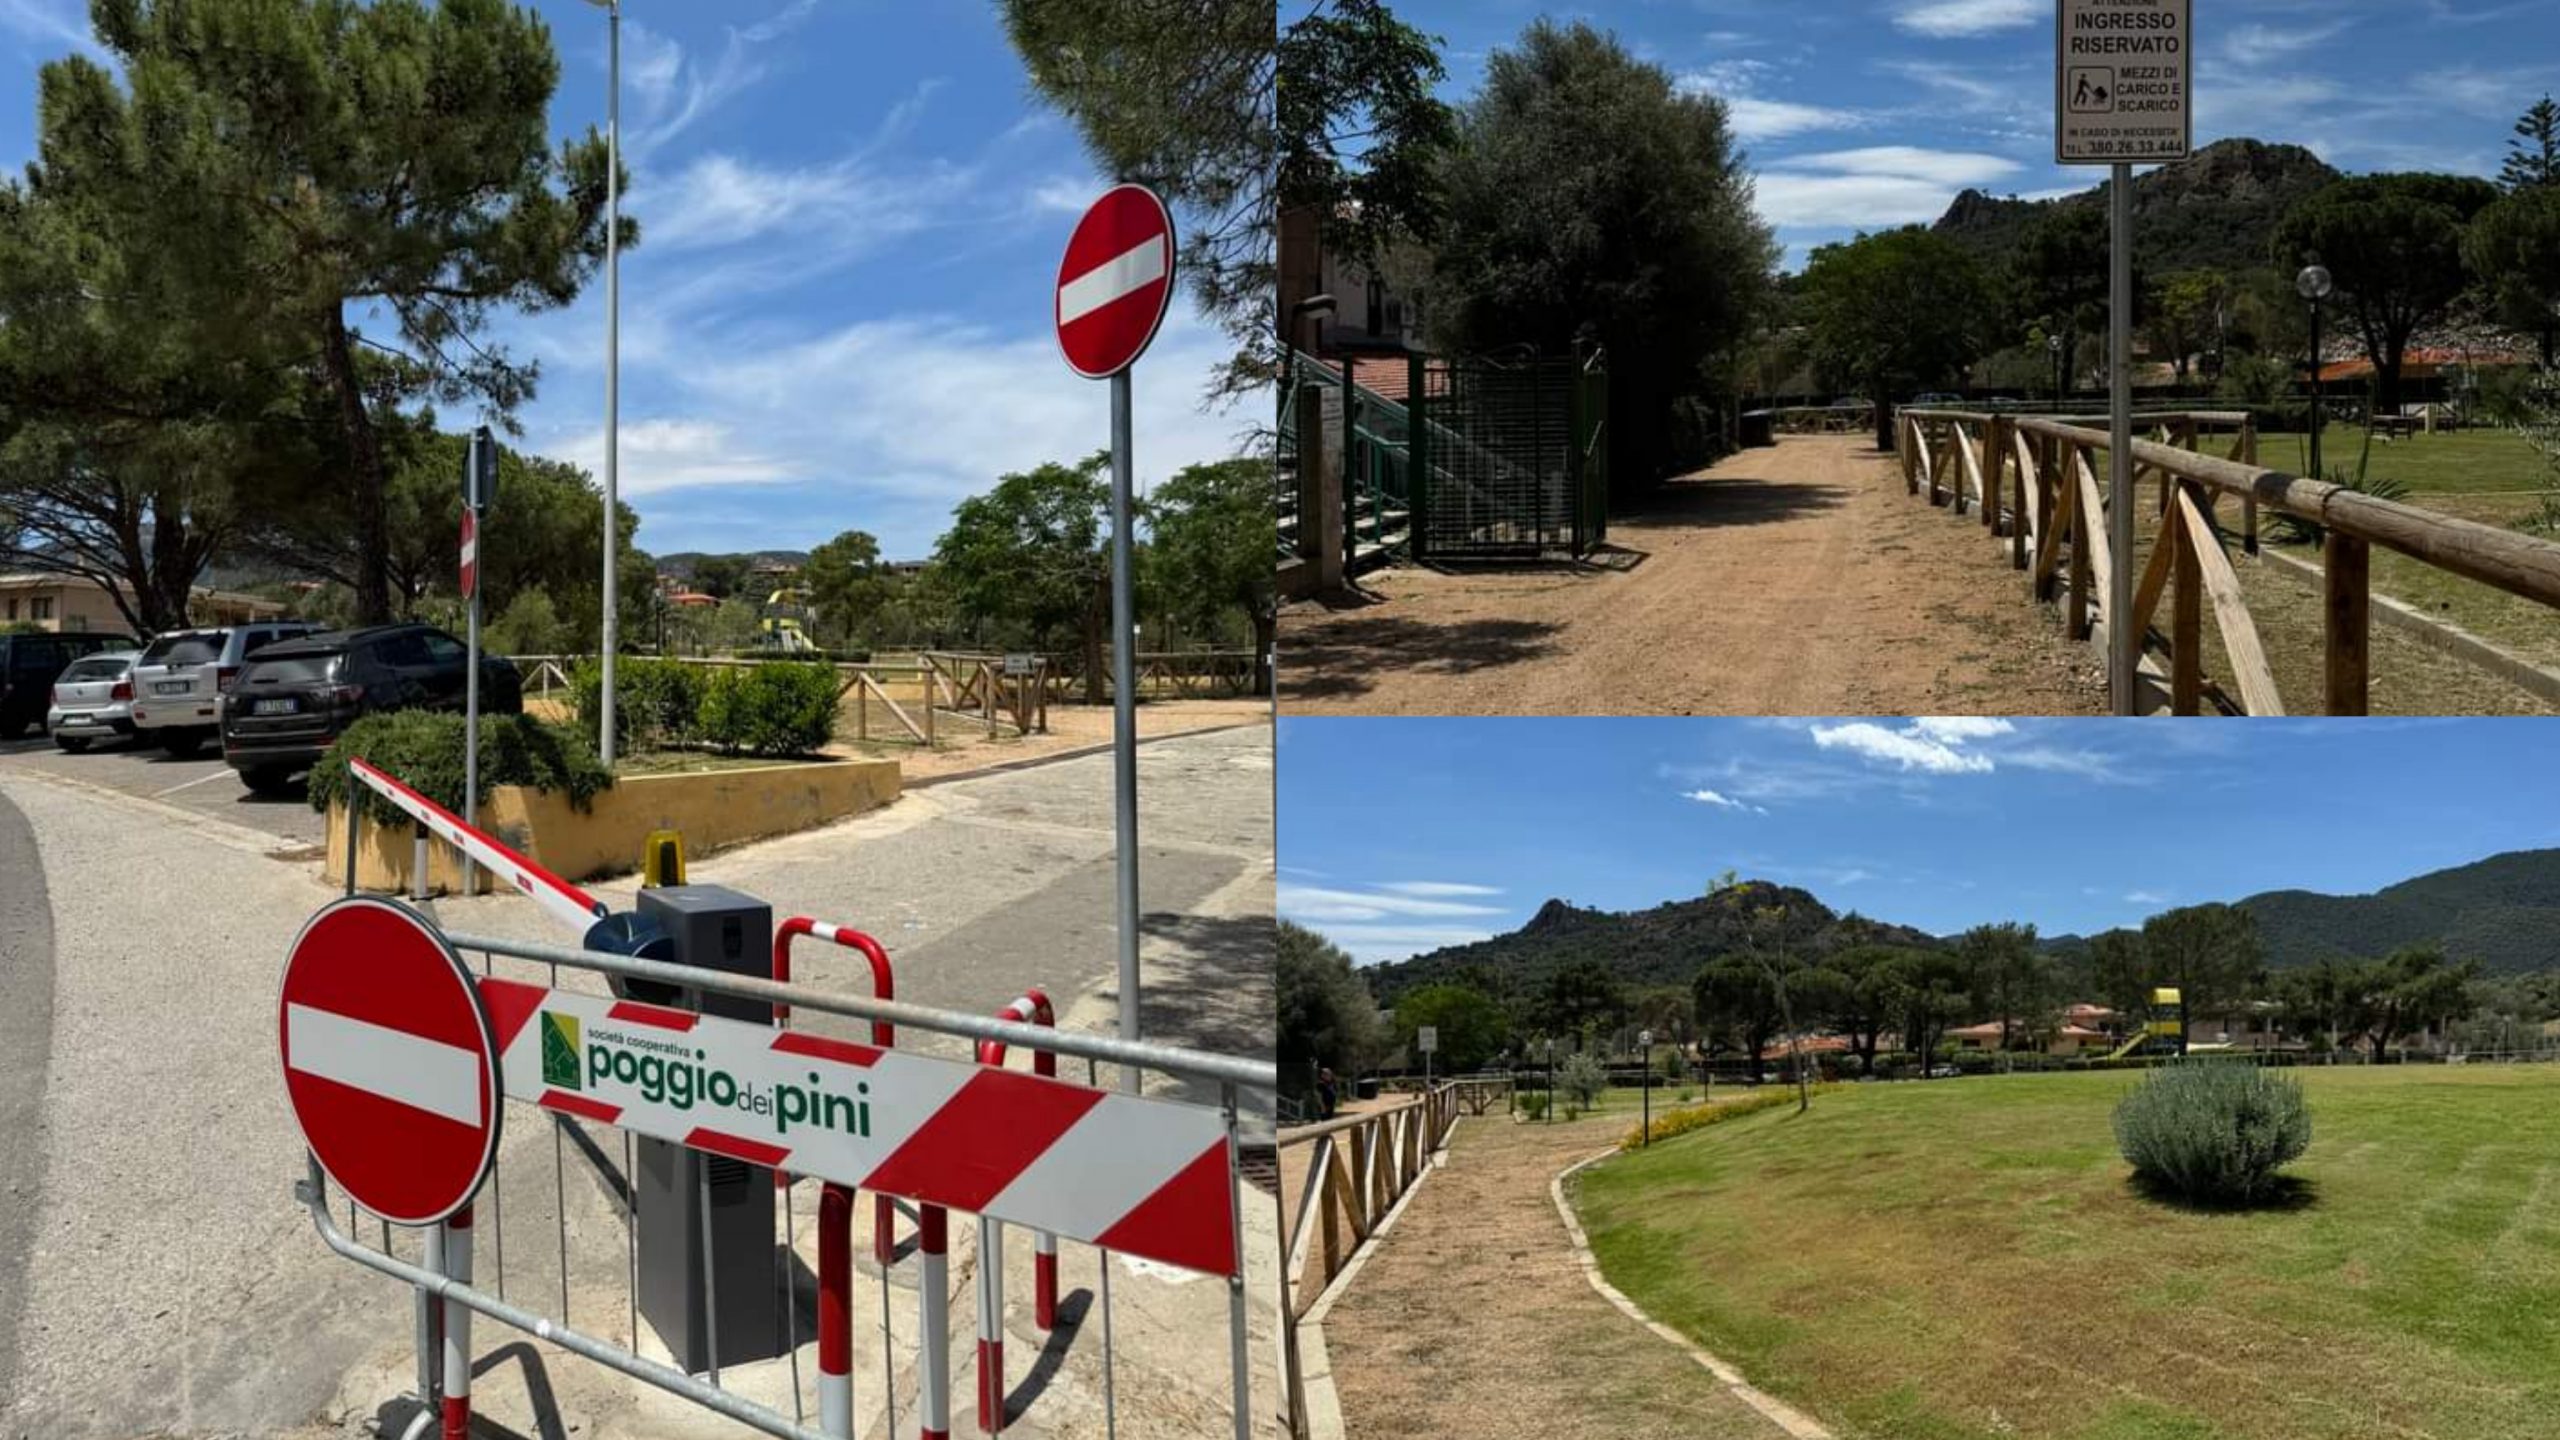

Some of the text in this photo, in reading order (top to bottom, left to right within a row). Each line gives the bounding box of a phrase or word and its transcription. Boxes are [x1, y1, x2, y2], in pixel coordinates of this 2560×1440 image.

[2075, 12, 2176, 29] INGRESSO
[2071, 36, 2179, 53] RISERVATO
[2121, 67, 2177, 78] MEZZI DI
[2116, 83, 2181, 95] CARICO E
[2118, 100, 2179, 112] SCARICO
[587, 1028, 691, 1059] società cooperativa
